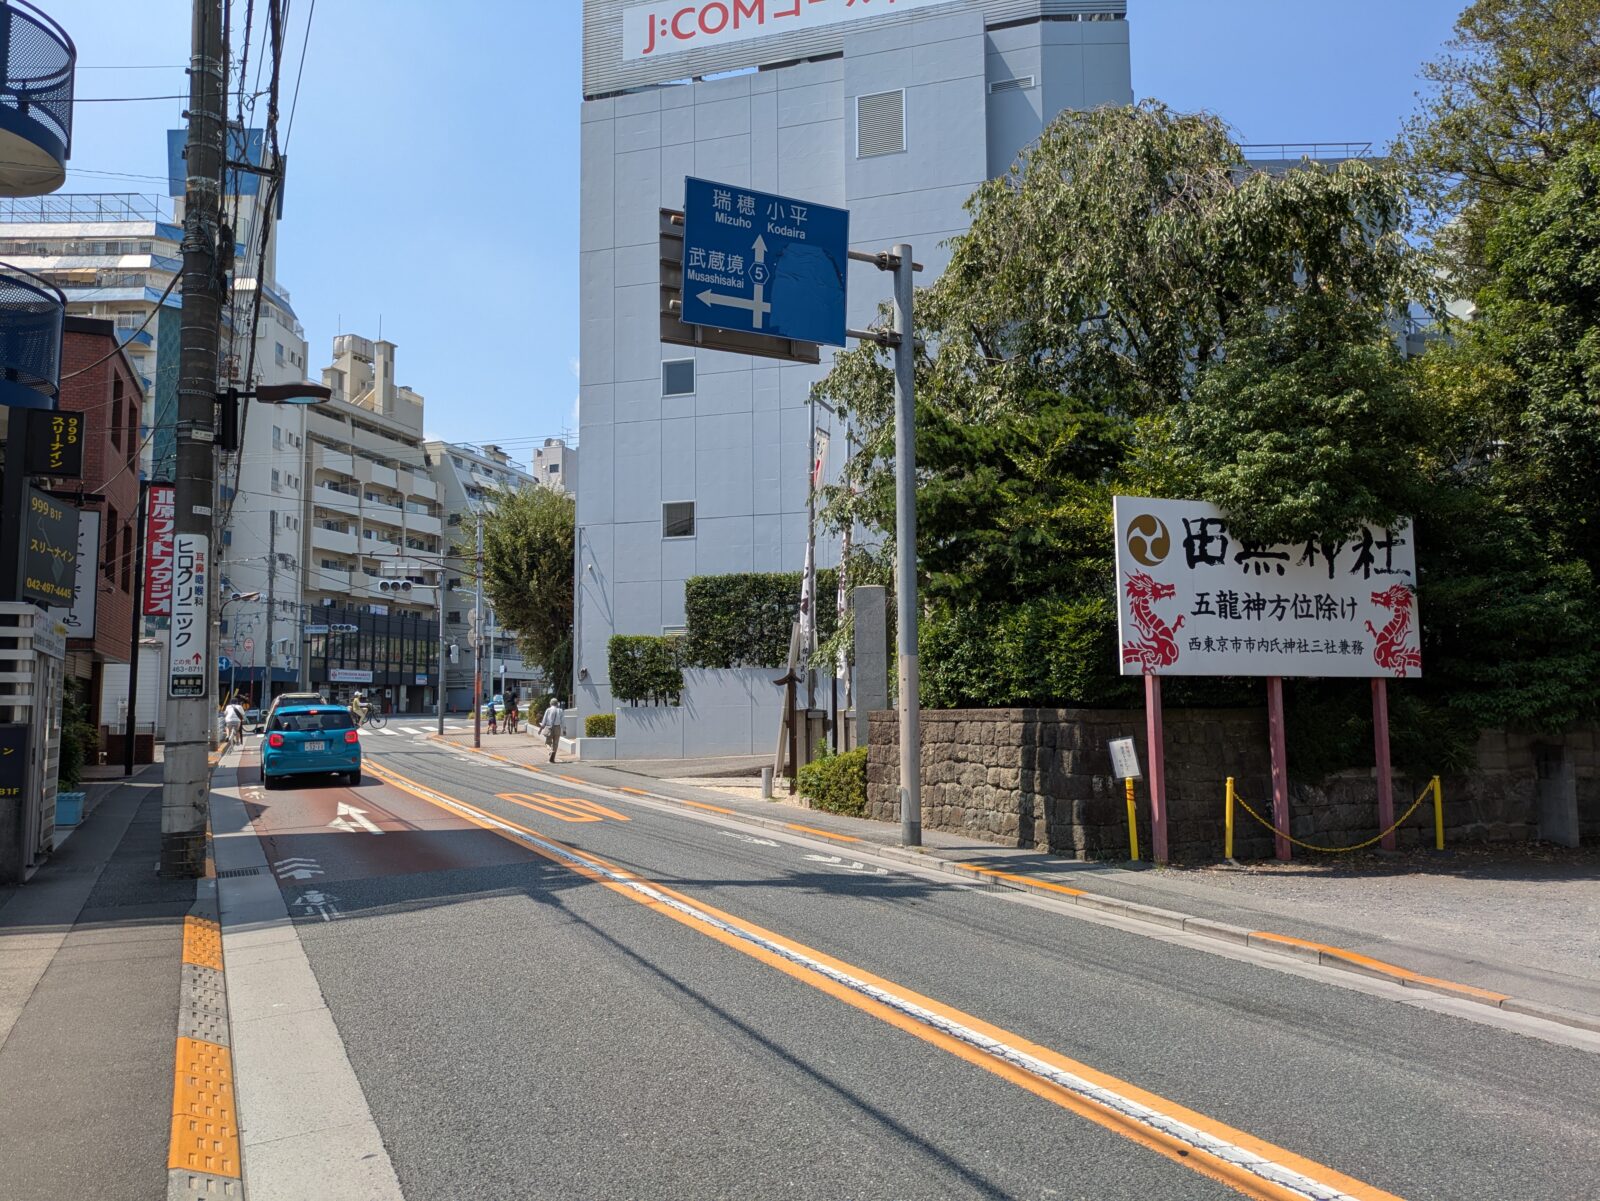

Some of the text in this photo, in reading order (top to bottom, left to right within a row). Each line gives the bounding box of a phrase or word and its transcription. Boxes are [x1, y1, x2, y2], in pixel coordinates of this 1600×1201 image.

[642, 0, 764, 54] J:COM
[712, 188, 756, 216] 瑞穂
[766, 201, 808, 226] 小平
[715, 211, 752, 229] Mizuho
[767, 222, 806, 240] Kodaira
[688, 246, 744, 276] 武蔵境
[754, 267, 764, 280] 5
[687, 268, 744, 289] Musashisakai
[50, 416, 65, 468] スリーナイン
[67, 417, 78, 444] 999
[31, 497, 49, 515] 999
[30, 538, 75, 563] スリーナイン
[148, 489, 175, 613] 北原フォトスタジオ
[26, 577, 72, 599] 042-497-4445
[175, 539, 194, 648] ヒロクリニック
[1190, 590, 1358, 622] 五龍神方位除け
[1188, 635, 1365, 655] 西東京市市内氏神社三社兼務
